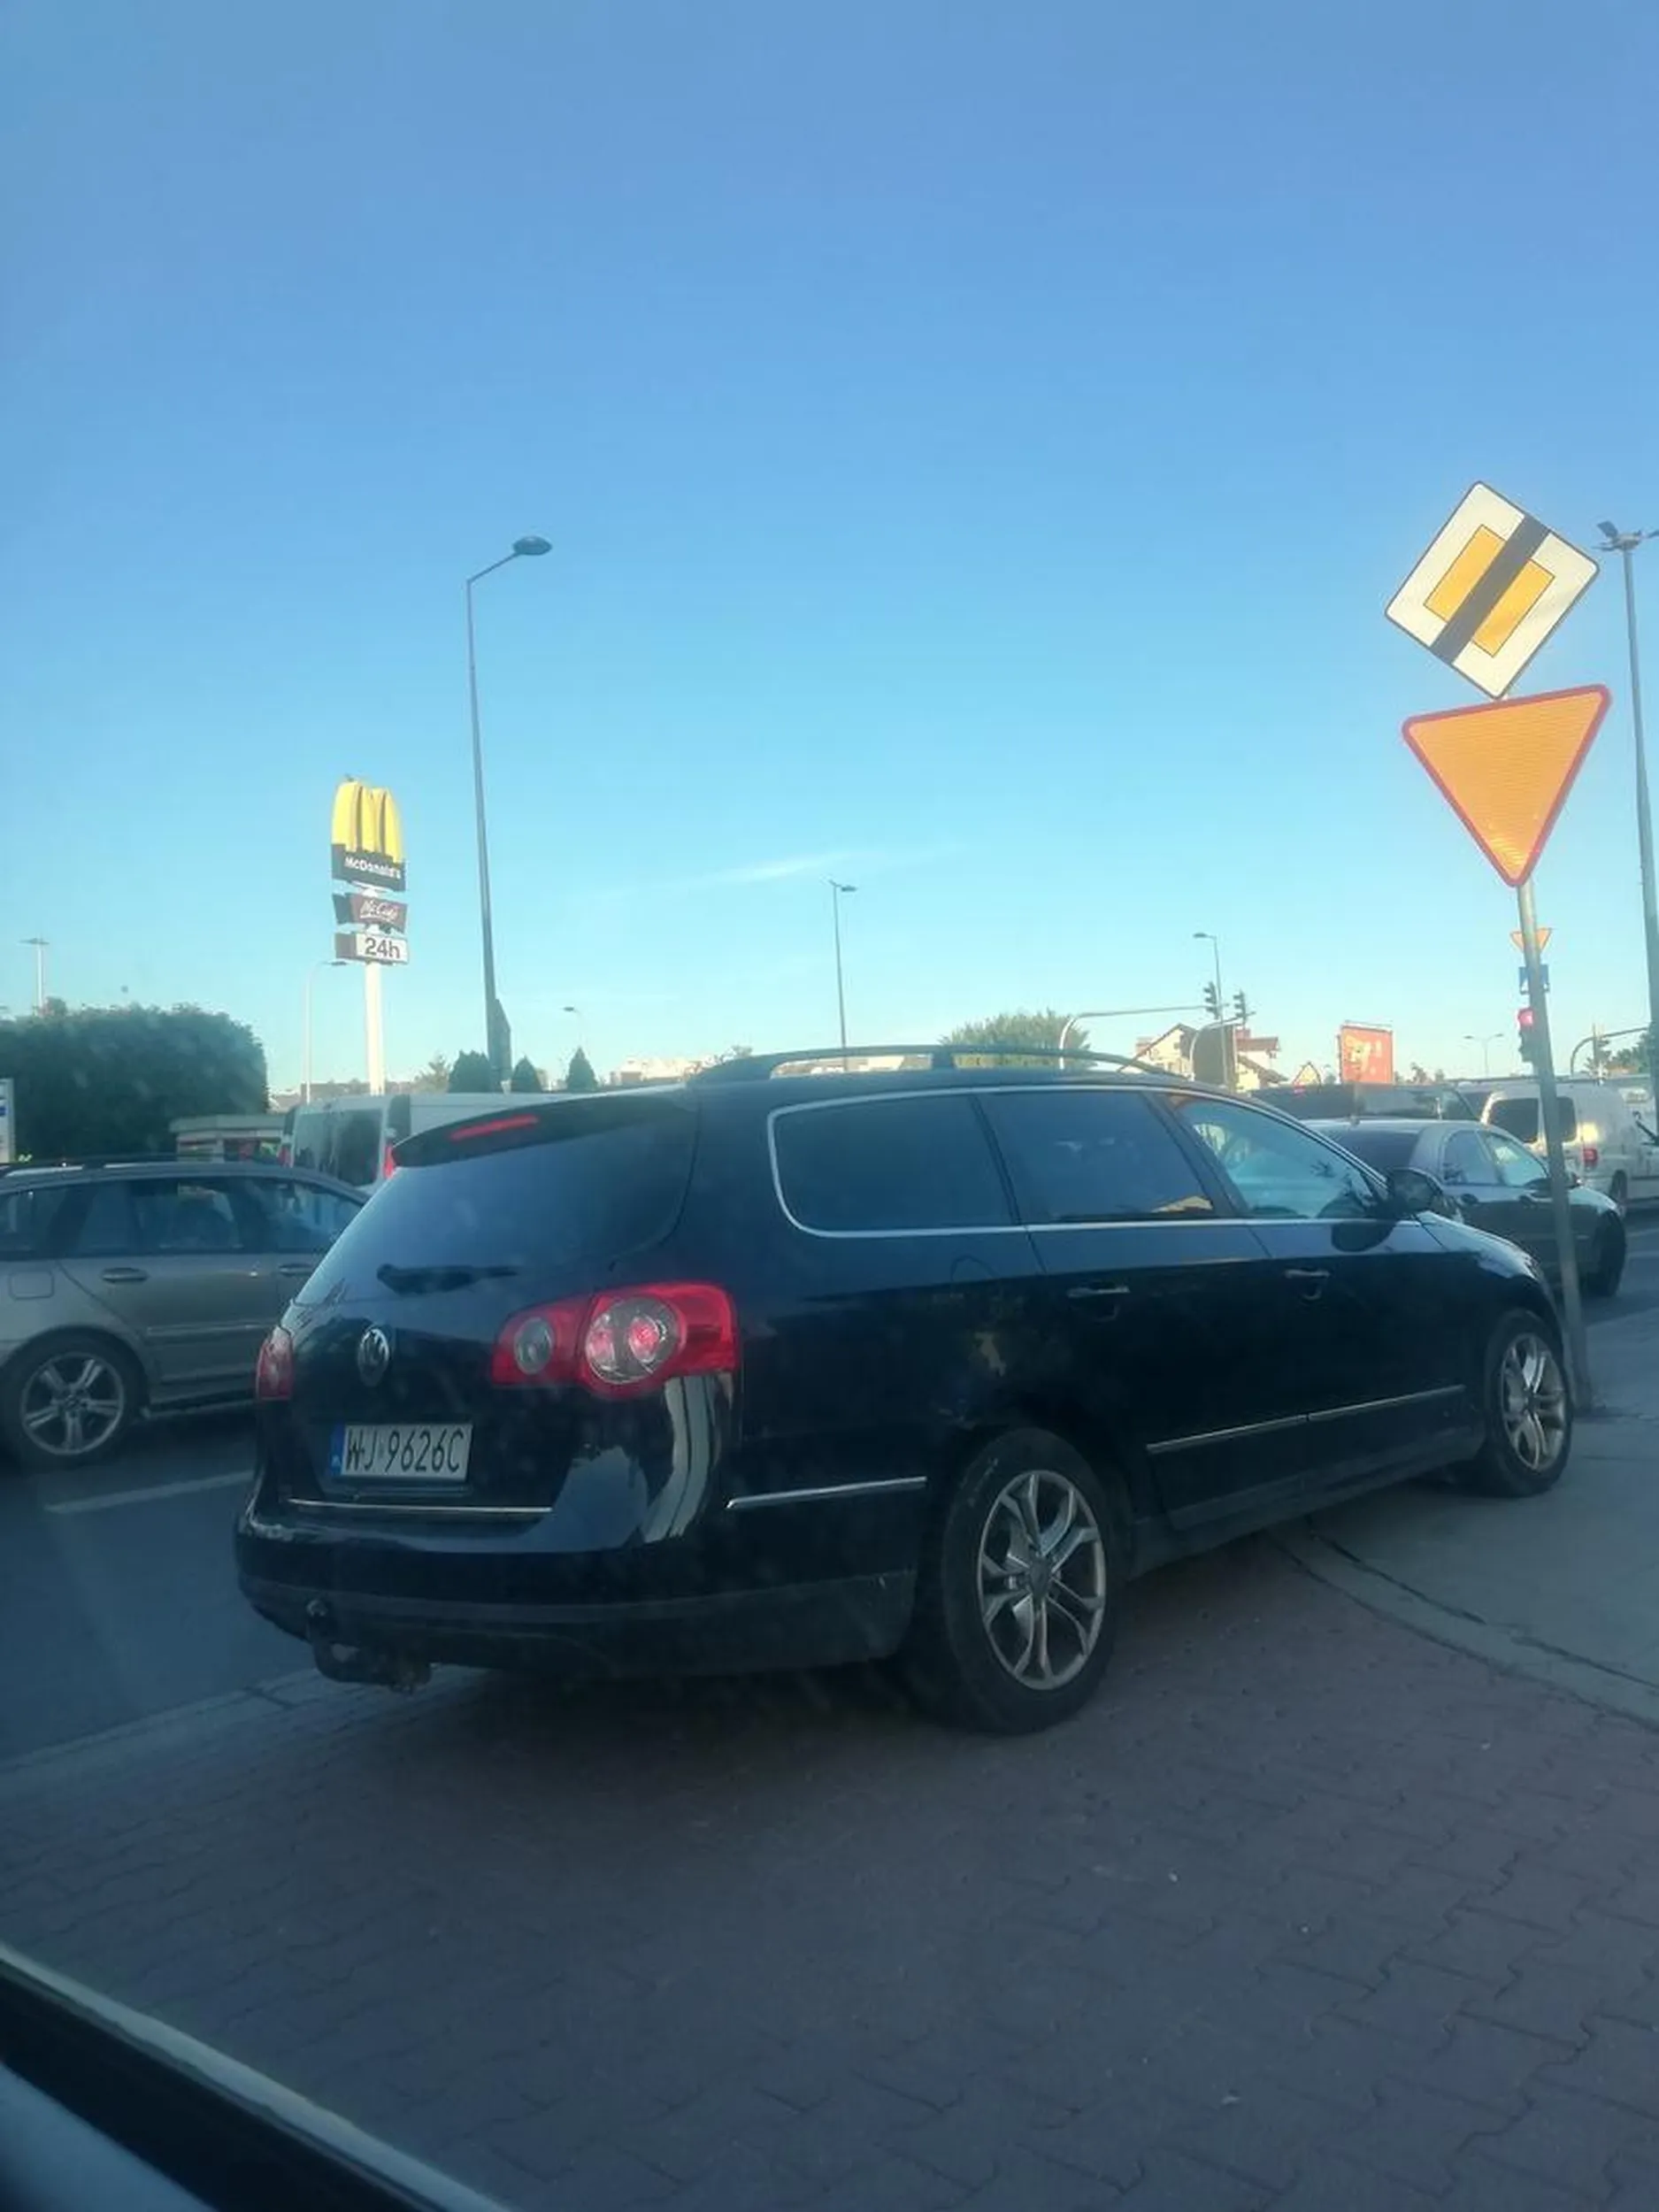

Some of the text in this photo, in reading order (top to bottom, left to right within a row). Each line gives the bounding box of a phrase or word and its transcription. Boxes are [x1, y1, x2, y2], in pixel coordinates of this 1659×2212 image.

[345, 856, 402, 879] McDonald's
[365, 937, 401, 959] 24h
[385, 1428, 465, 1472] 9626C
